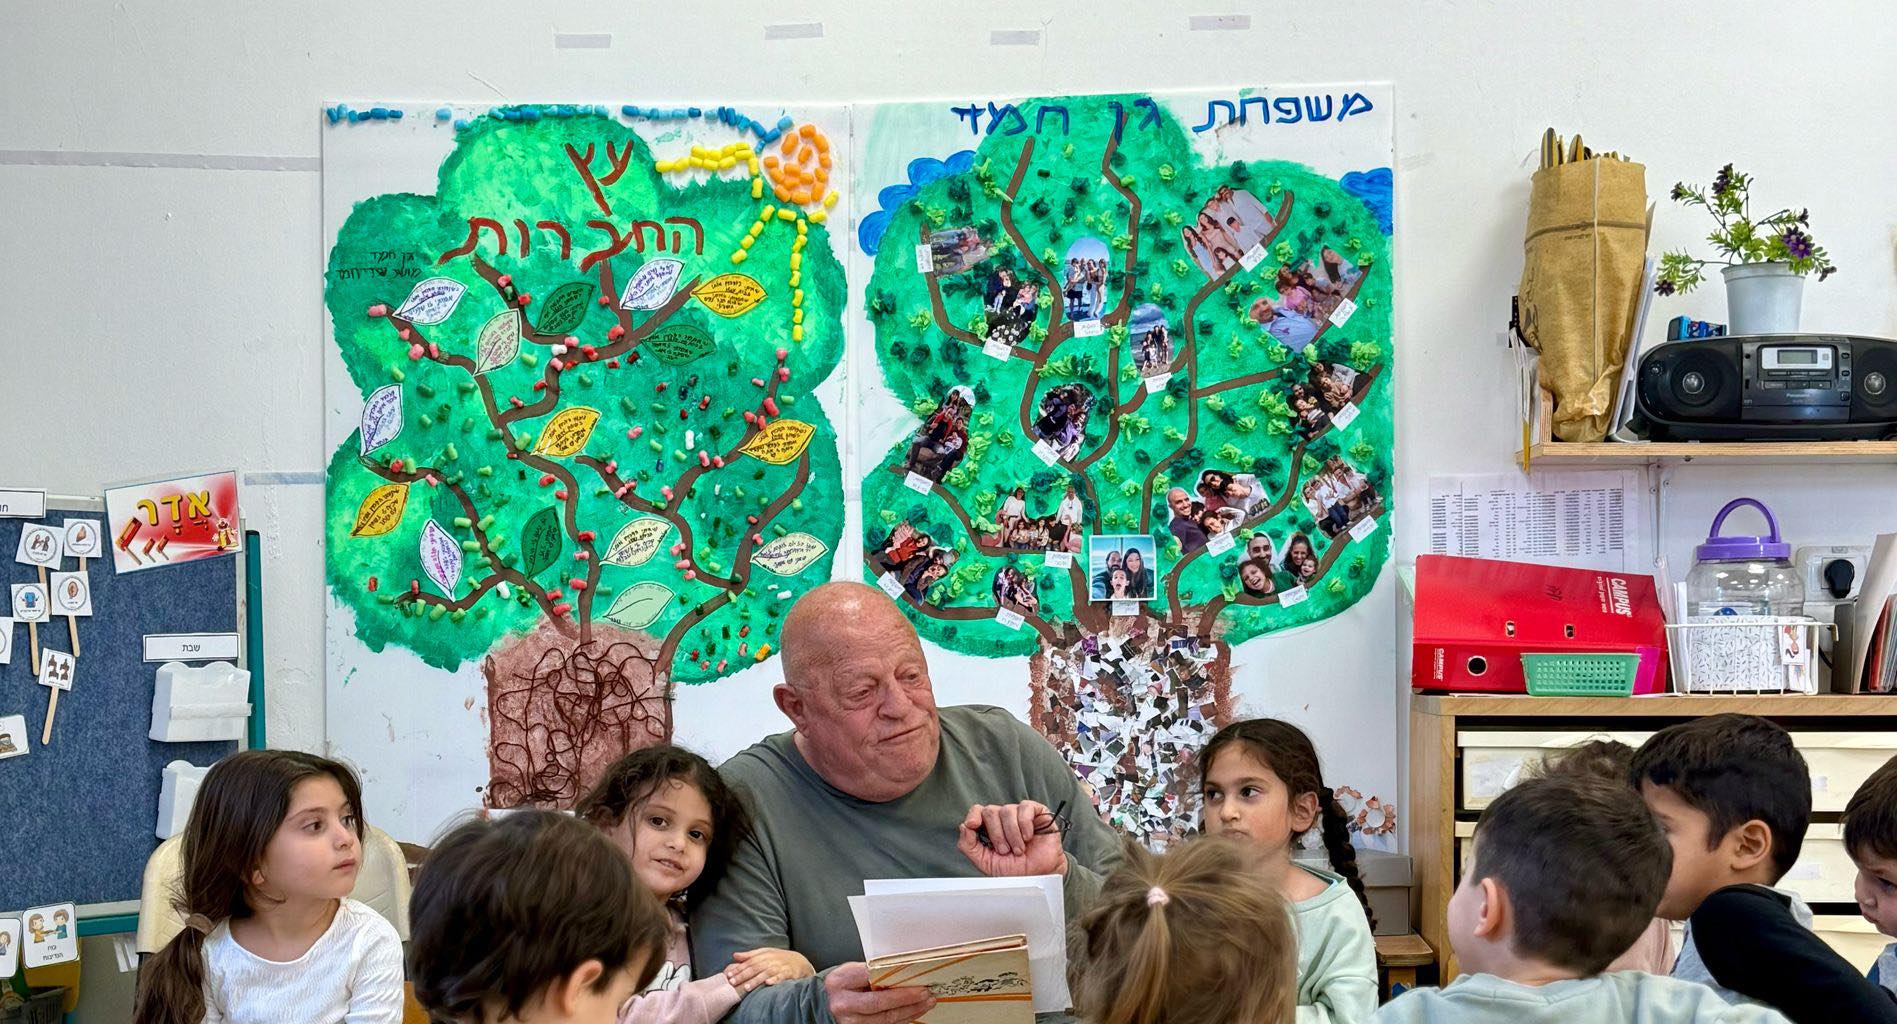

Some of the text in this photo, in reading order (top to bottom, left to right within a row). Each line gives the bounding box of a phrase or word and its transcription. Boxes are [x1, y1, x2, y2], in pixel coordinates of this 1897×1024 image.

[951, 92, 1373, 147] משפחת גן חמד
[564, 139, 634, 217] עץ
[437, 216, 705, 273] החברות
[1611, 578, 1632, 617] CAMPUS
[182, 644, 201, 652] שבת
